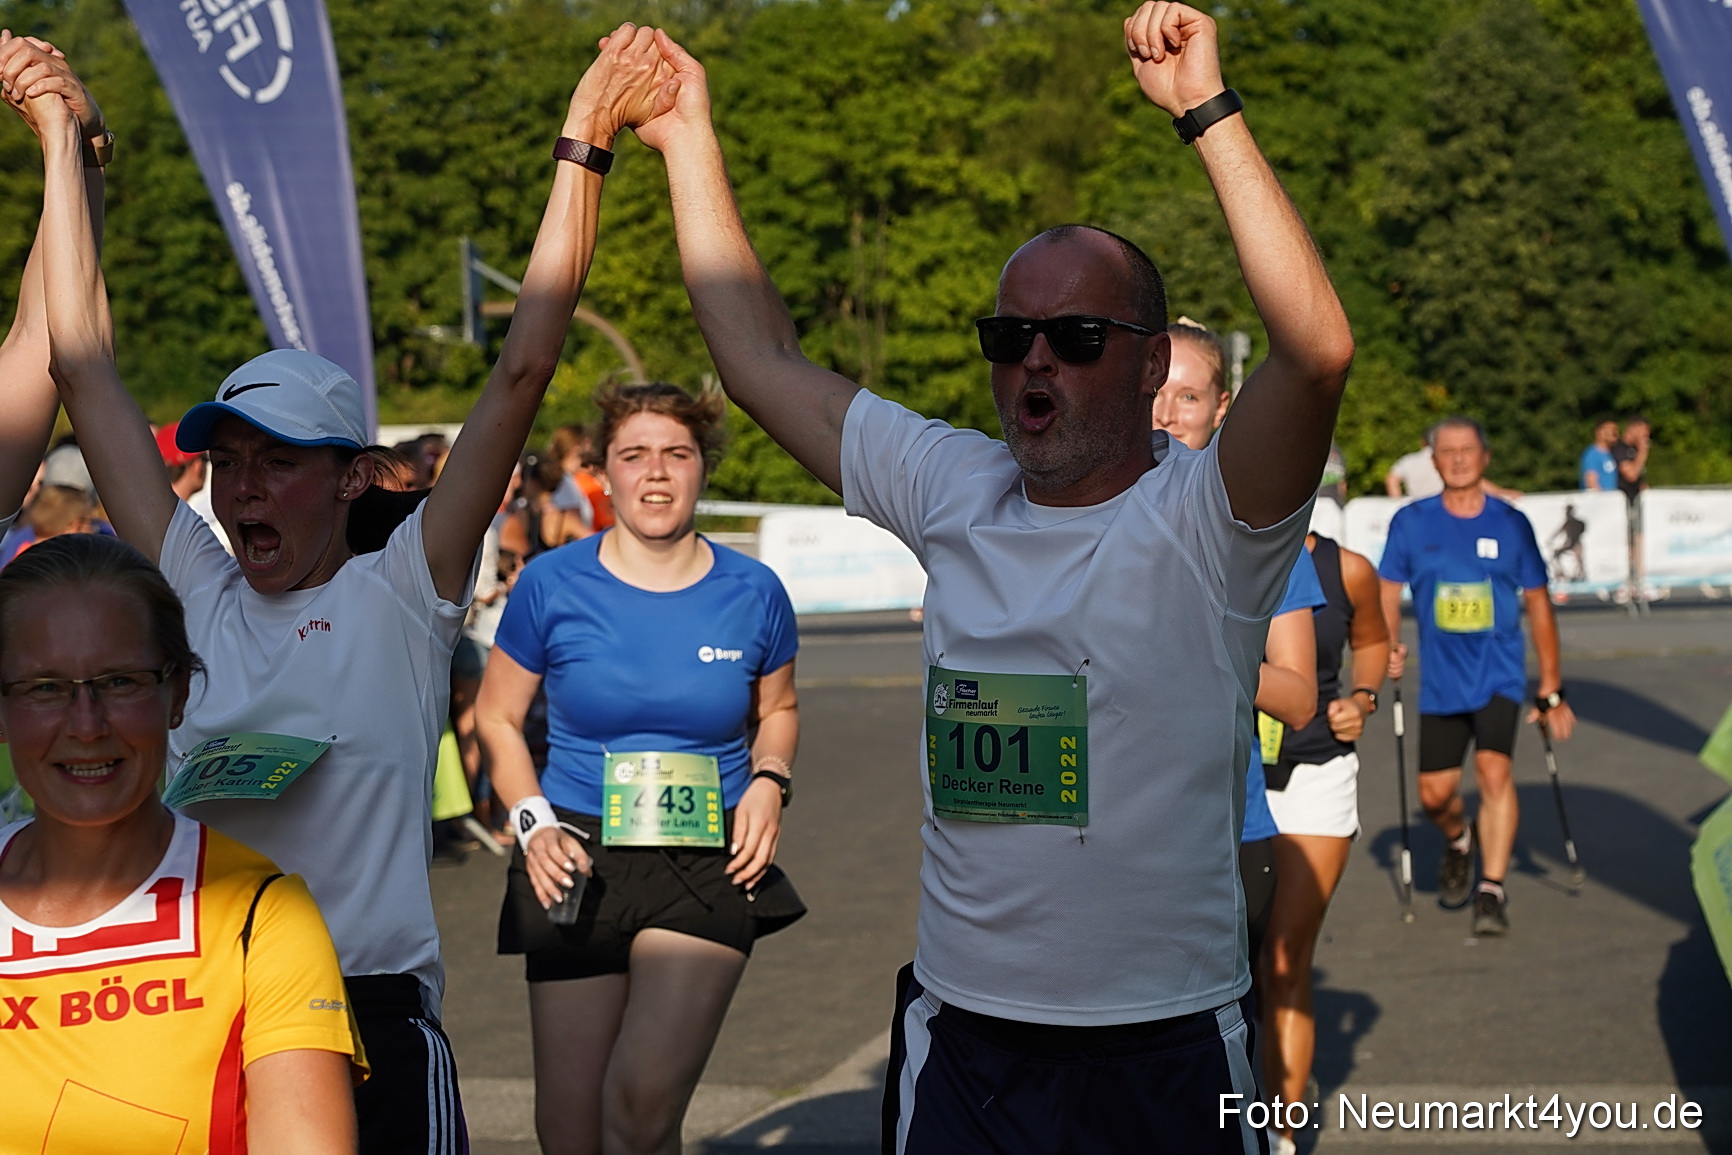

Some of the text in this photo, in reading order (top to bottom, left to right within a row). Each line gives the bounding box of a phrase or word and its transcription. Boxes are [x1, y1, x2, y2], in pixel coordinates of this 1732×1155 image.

[949, 699, 999, 710] Firmenlauf
[965, 709, 998, 717] neumarkt
[948, 722, 1030, 774] 101
[180, 755, 265, 790] 105
[260, 761, 299, 790] 2022
[1060, 736, 1077, 803] 2022
[214, 777, 263, 788] Katrin
[942, 774, 1045, 796] Decker Rene
[953, 797, 997, 808] Strahlentherapie
[674, 817, 701, 829] Lena
[0, 975, 204, 1030] X BÖGL
